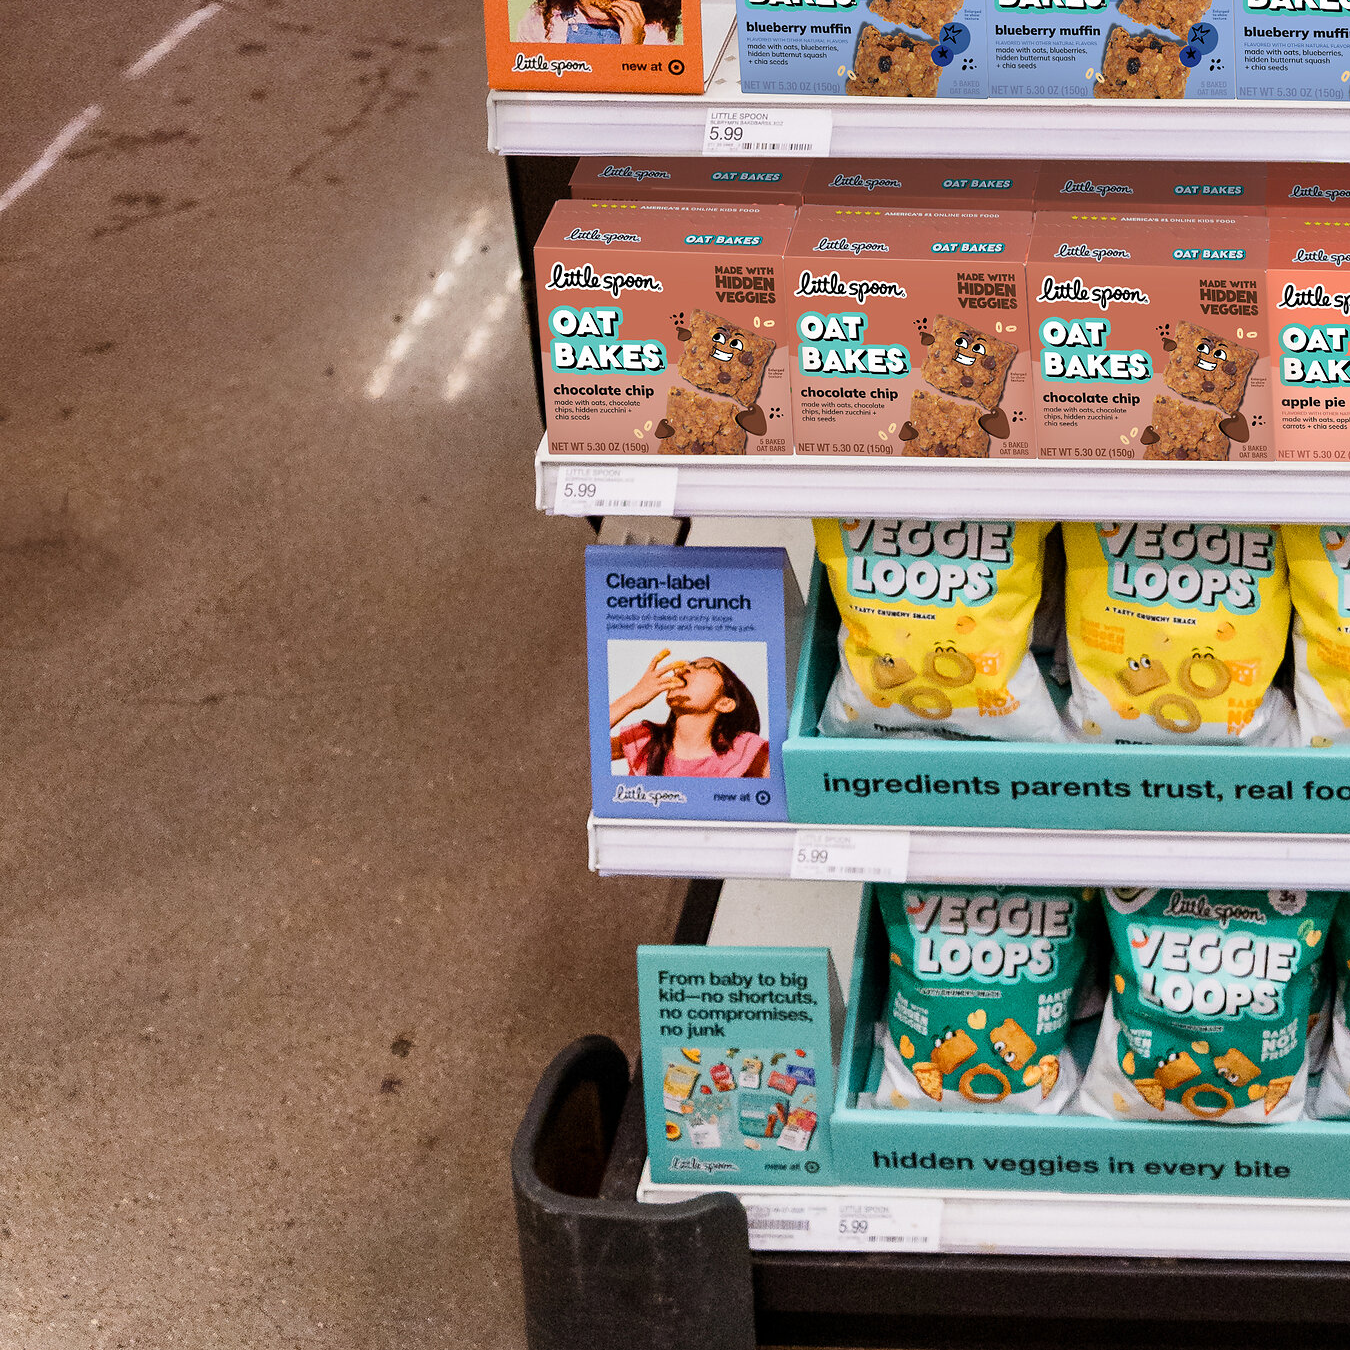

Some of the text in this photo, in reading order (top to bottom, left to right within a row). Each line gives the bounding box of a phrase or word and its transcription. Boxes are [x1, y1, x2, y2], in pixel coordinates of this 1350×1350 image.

[746, 21, 852, 36] blueberry muffin
[709, 127, 743, 142] 5.99
[552, 308, 619, 337] OAT
[553, 343, 660, 371] BAKES
[553, 383, 654, 400] chocolate chip
[564, 483, 596, 498] 5.99
[606, 573, 711, 592] Clean-label
[606, 592, 752, 611] certified crunch
[823, 773, 1000, 800] ingredients
[1011, 778, 1130, 800] parents
[1141, 781, 1223, 803] trust,
[1234, 779, 1293, 800] real
[797, 848, 828, 864] 5.99
[658, 971, 807, 991] From baby to big
[729, 990, 817, 1007] shortcuts,
[659, 1007, 813, 1025] no compromises,
[659, 1023, 725, 1040] no junk
[872, 1150, 1290, 1180] hidden veggies in every bite
[838, 1219, 867, 1233] 5.99
